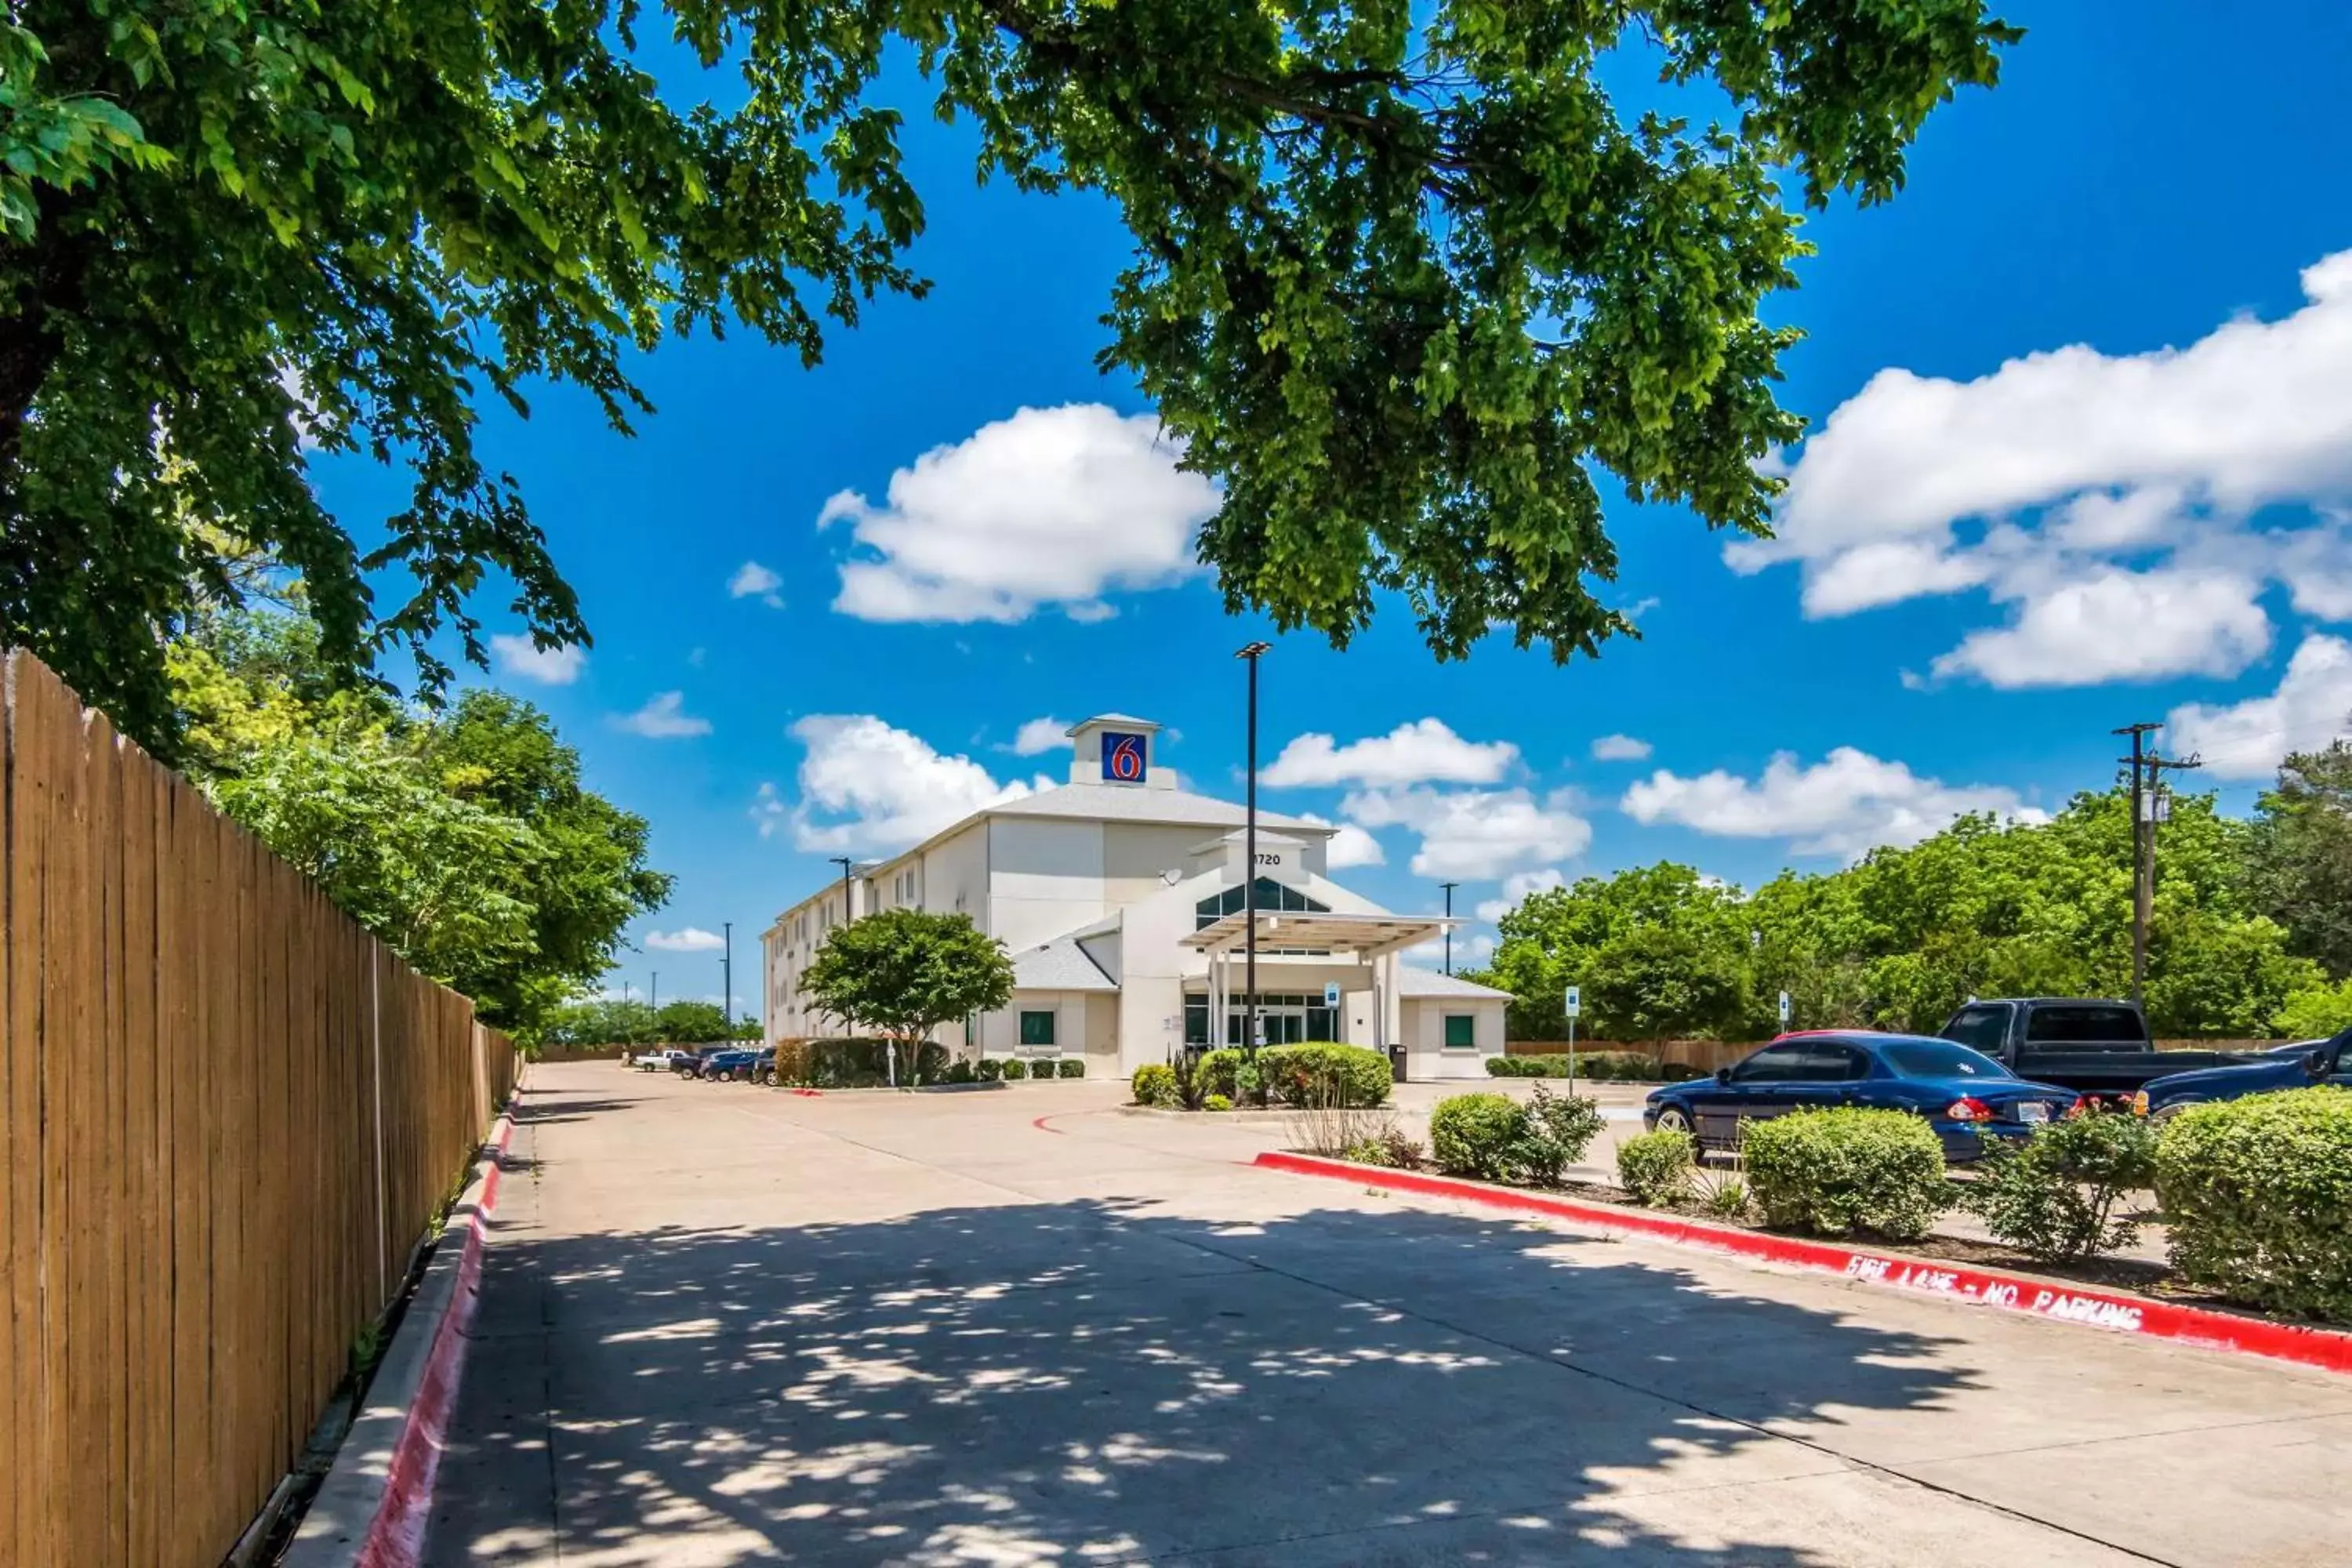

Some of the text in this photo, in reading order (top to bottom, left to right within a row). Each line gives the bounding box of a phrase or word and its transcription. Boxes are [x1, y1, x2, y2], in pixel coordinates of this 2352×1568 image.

[1112, 736, 1141, 779] 6
[1981, 1281, 2019, 1305] NO
[2032, 1290, 2143, 1330] PARKING
